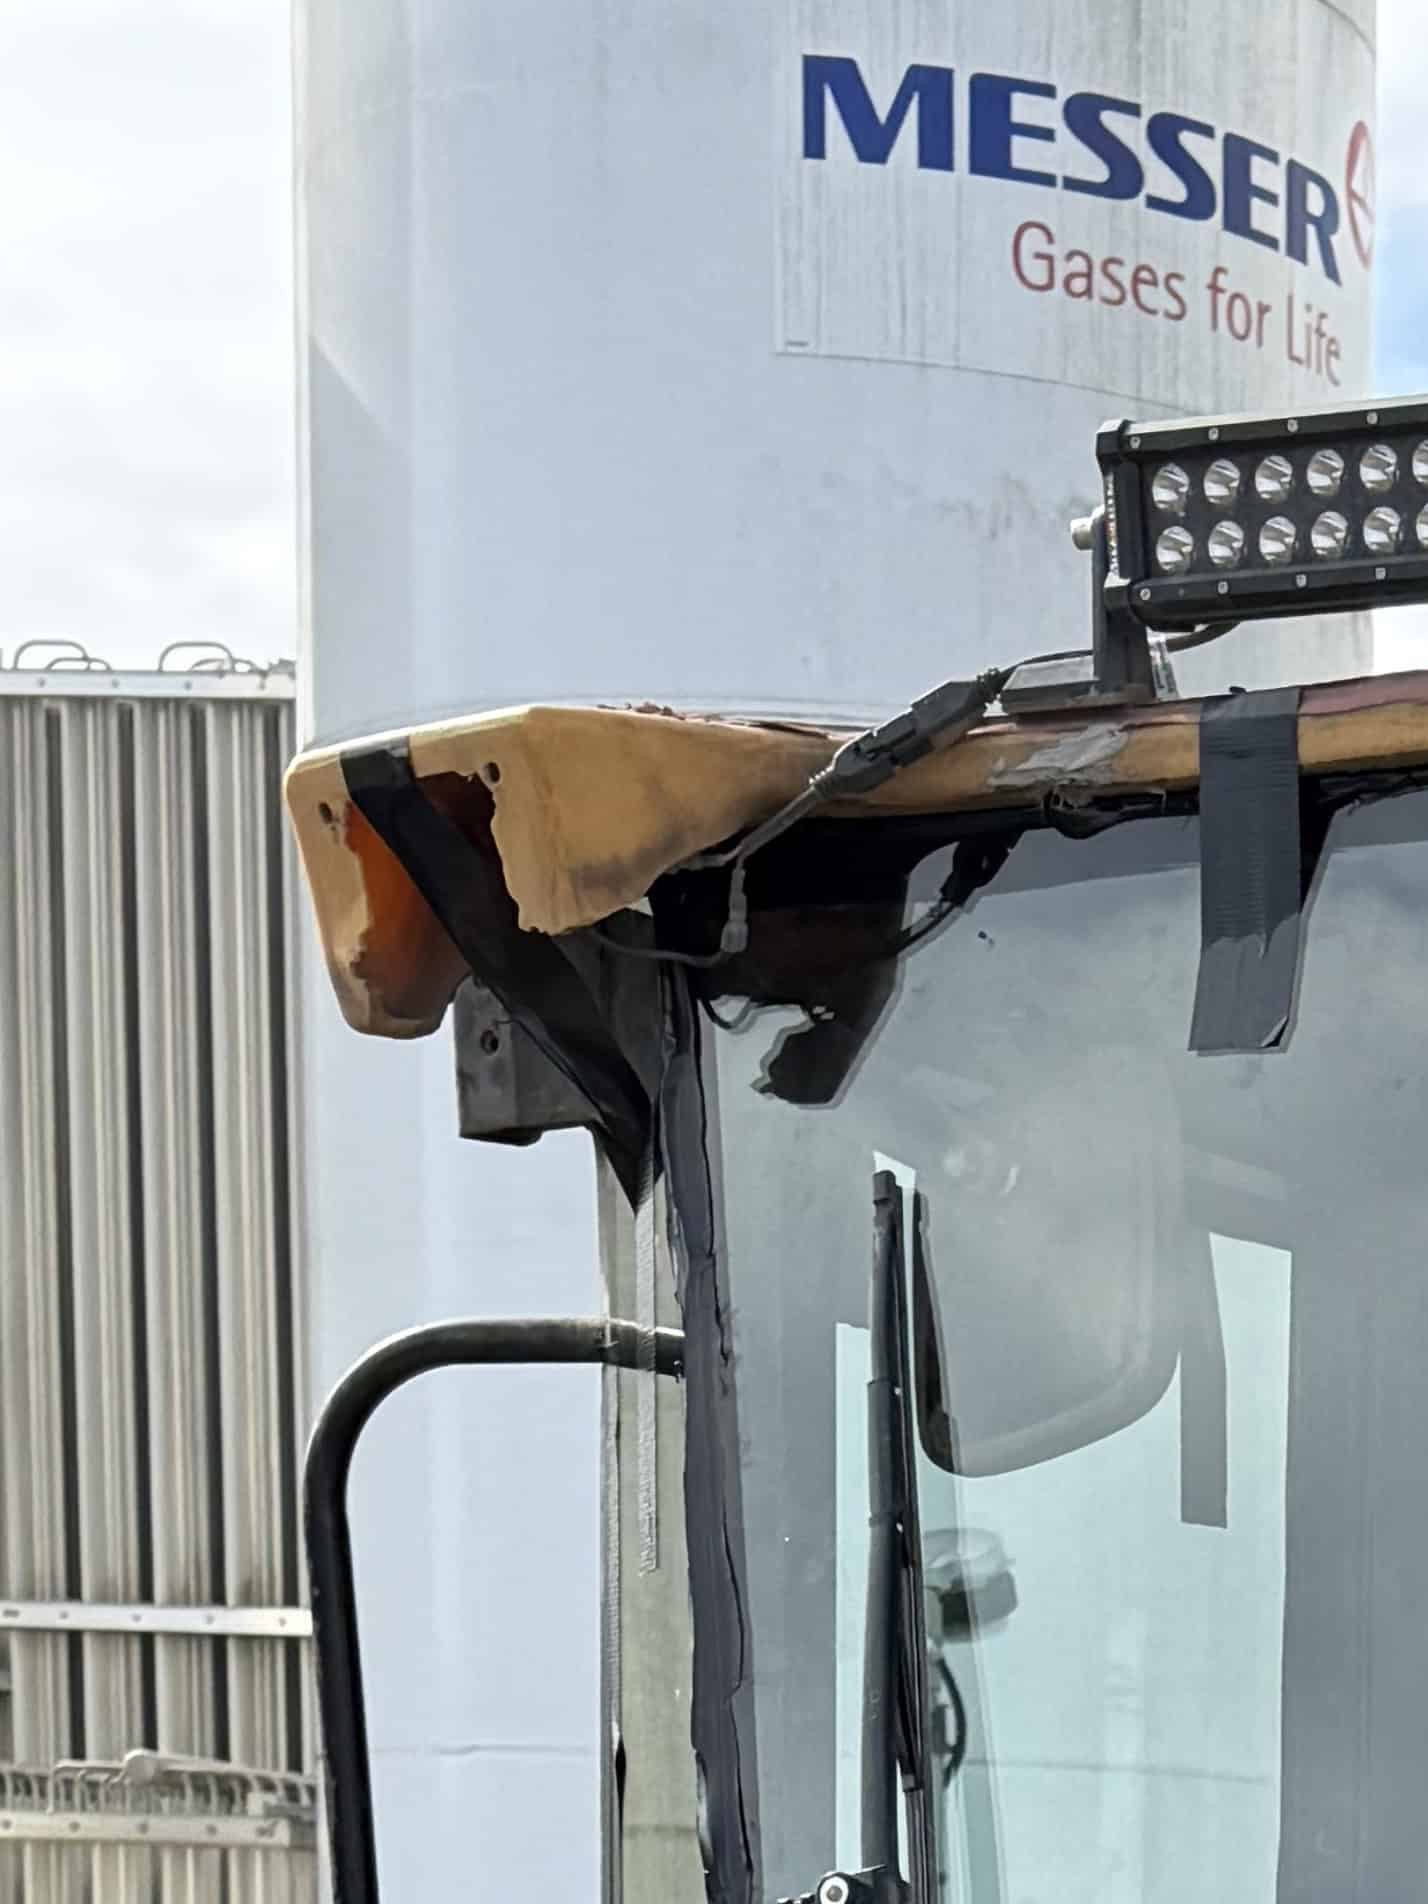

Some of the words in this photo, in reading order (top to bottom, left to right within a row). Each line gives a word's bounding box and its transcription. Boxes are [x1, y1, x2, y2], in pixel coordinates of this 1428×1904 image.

[803, 54, 1341, 287] MESSER
[1012, 221, 1187, 322] Gases
[1207, 266, 1271, 349] for
[1286, 293, 1342, 388] Life
